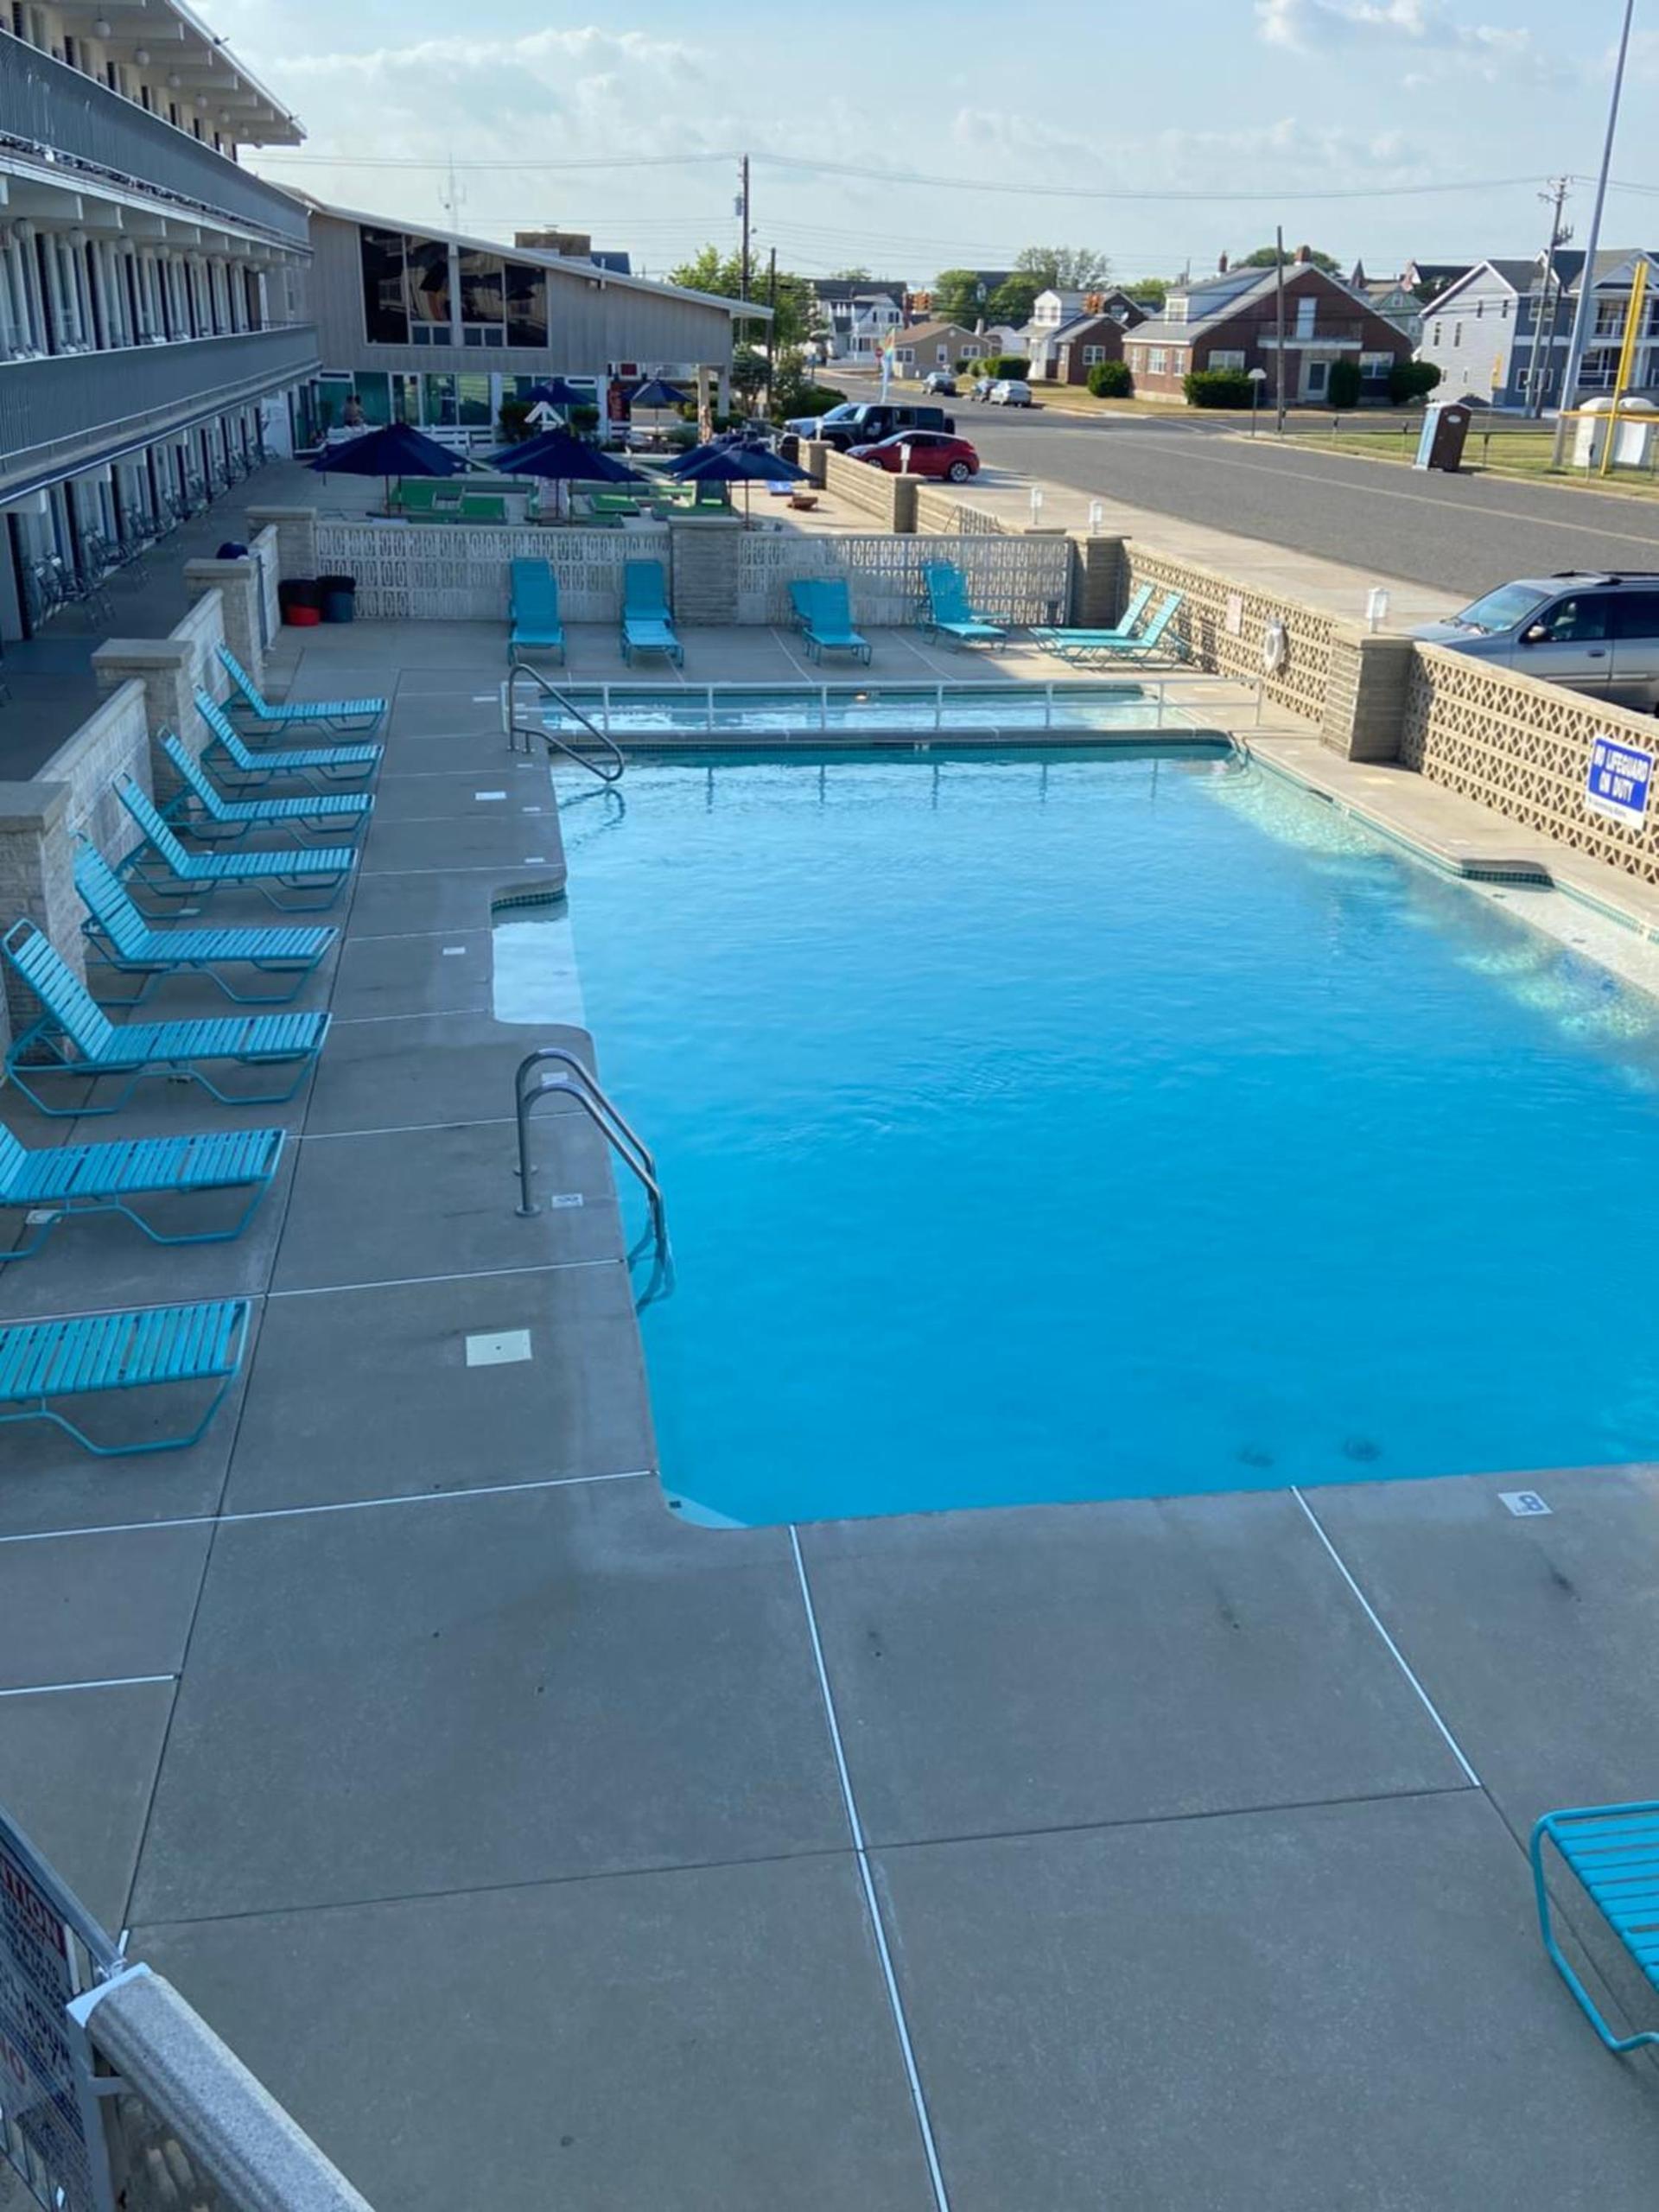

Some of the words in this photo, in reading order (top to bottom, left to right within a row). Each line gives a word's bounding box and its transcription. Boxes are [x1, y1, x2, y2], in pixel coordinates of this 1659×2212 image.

[1594, 745, 1605, 767] NO
[1606, 749, 1649, 783] LIFEGUARD
[1599, 771, 1611, 792] ON
[1612, 776, 1634, 803] DUTY
